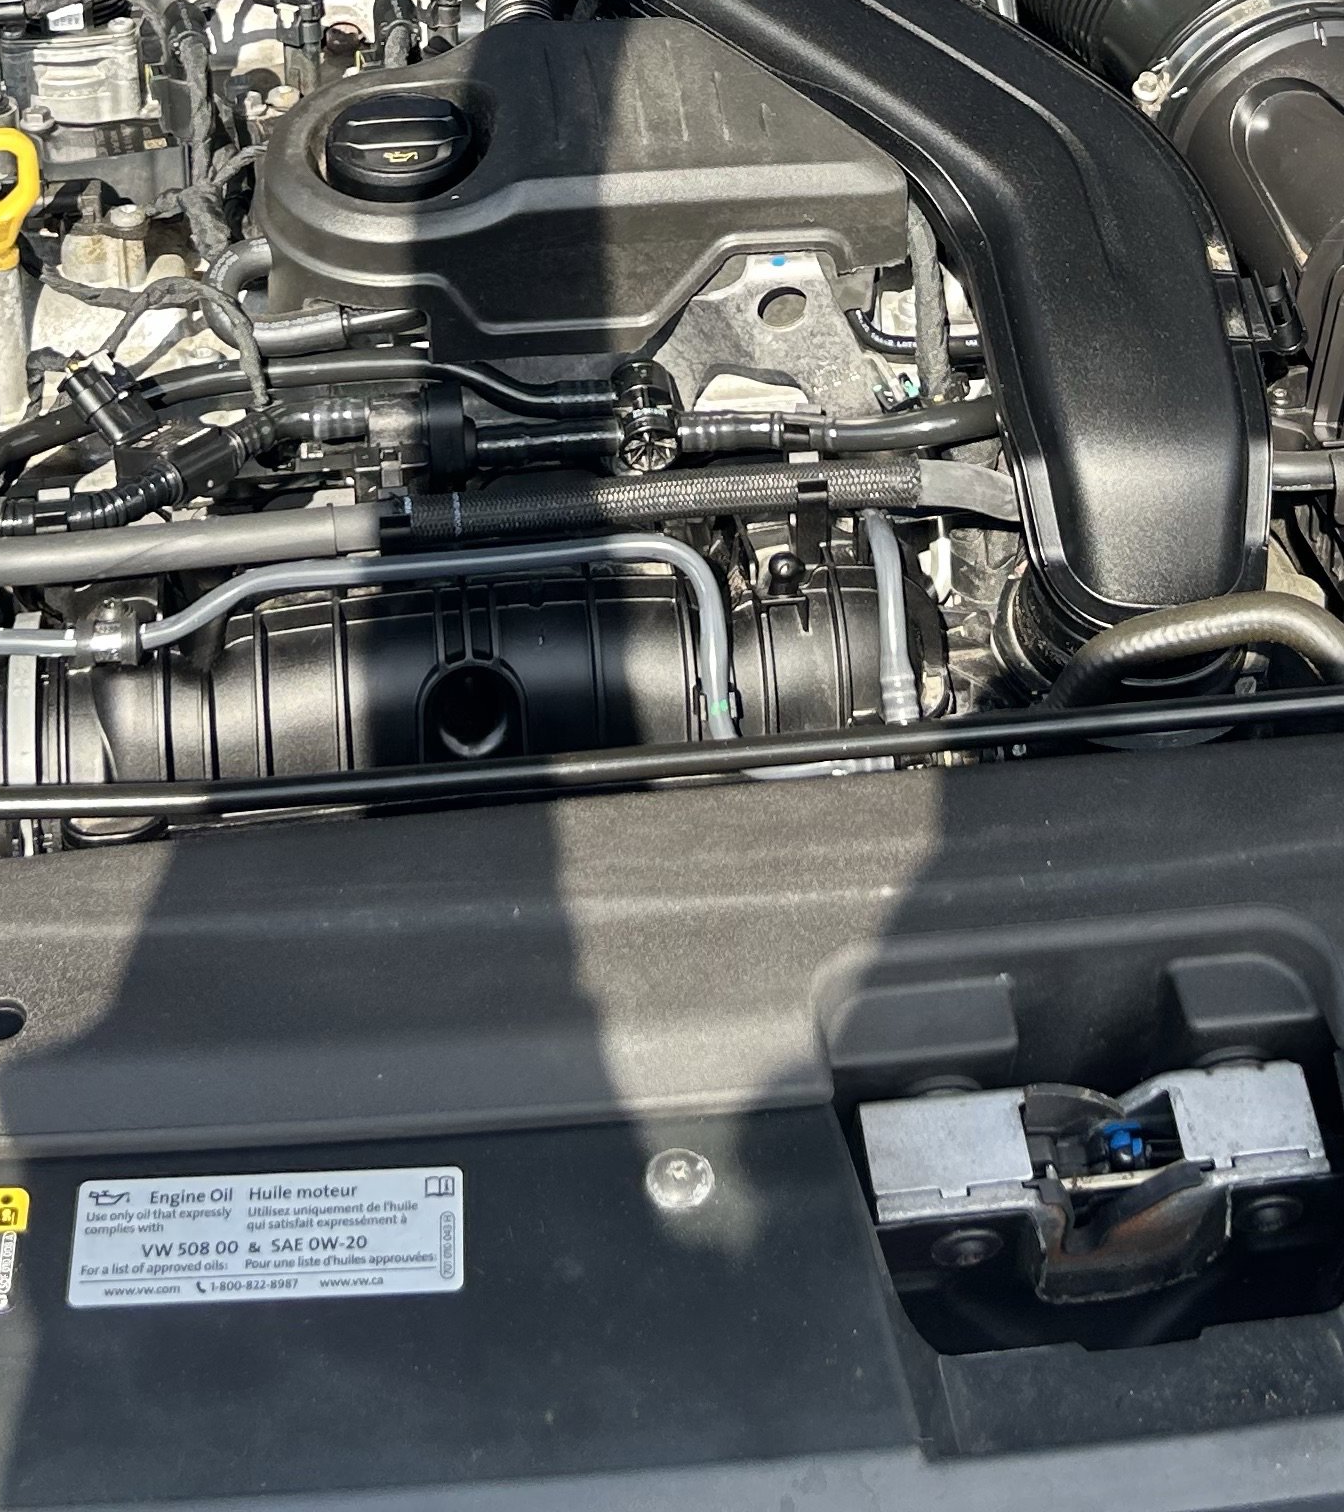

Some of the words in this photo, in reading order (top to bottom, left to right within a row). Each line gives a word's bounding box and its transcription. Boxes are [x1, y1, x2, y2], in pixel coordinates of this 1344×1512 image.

[150, 1190, 206, 1207] Engine
[210, 1188, 233, 1202] Oil
[249, 1186, 292, 1200] Huile
[297, 1185, 358, 1199] moteur
[86, 1211, 107, 1222] Use
[110, 1210, 134, 1223] only
[137, 1209, 151, 1220] oil
[153, 1208, 176, 1219] that
[179, 1207, 232, 1220] expressly
[248, 1206, 291, 1217] Utilisez
[293, 1203, 364, 1217] uniquement
[366, 1201, 381, 1213] de
[384, 1200, 419, 1211] l'huile
[85, 1223, 135, 1237] complies
[138, 1222, 164, 1233] with
[247, 1219, 266, 1232] qui
[268, 1216, 314, 1229] satisfait
[317, 1214, 397, 1229] expressément
[400, 1213, 407, 1224] à
[142, 1242, 174, 1257] VW
[178, 1241, 210, 1256] 508
[215, 1240, 239, 1254] 00
[248, 1242, 261, 1253] &
[272, 1237, 304, 1252] SAE
[309, 1235, 368, 1251] 0W-20
[81, 1265, 100, 1276] For
[102, 1266, 109, 1274] a
[112, 1262, 129, 1274] list
[131, 1262, 144, 1274] of
[146, 1261, 202, 1276] approved
[204, 1259, 228, 1271] oils:
[245, 1257, 271, 1269] Pour
[273, 1258, 295, 1268] une
[298, 1255, 320, 1267] liste
[323, 1254, 366, 1267] d'huiles
[104, 1284, 181, 1296] www.vw.com
[211, 1278, 299, 1292] 1-800-822-8987
[320, 1276, 384, 1288] www.vw.ca
